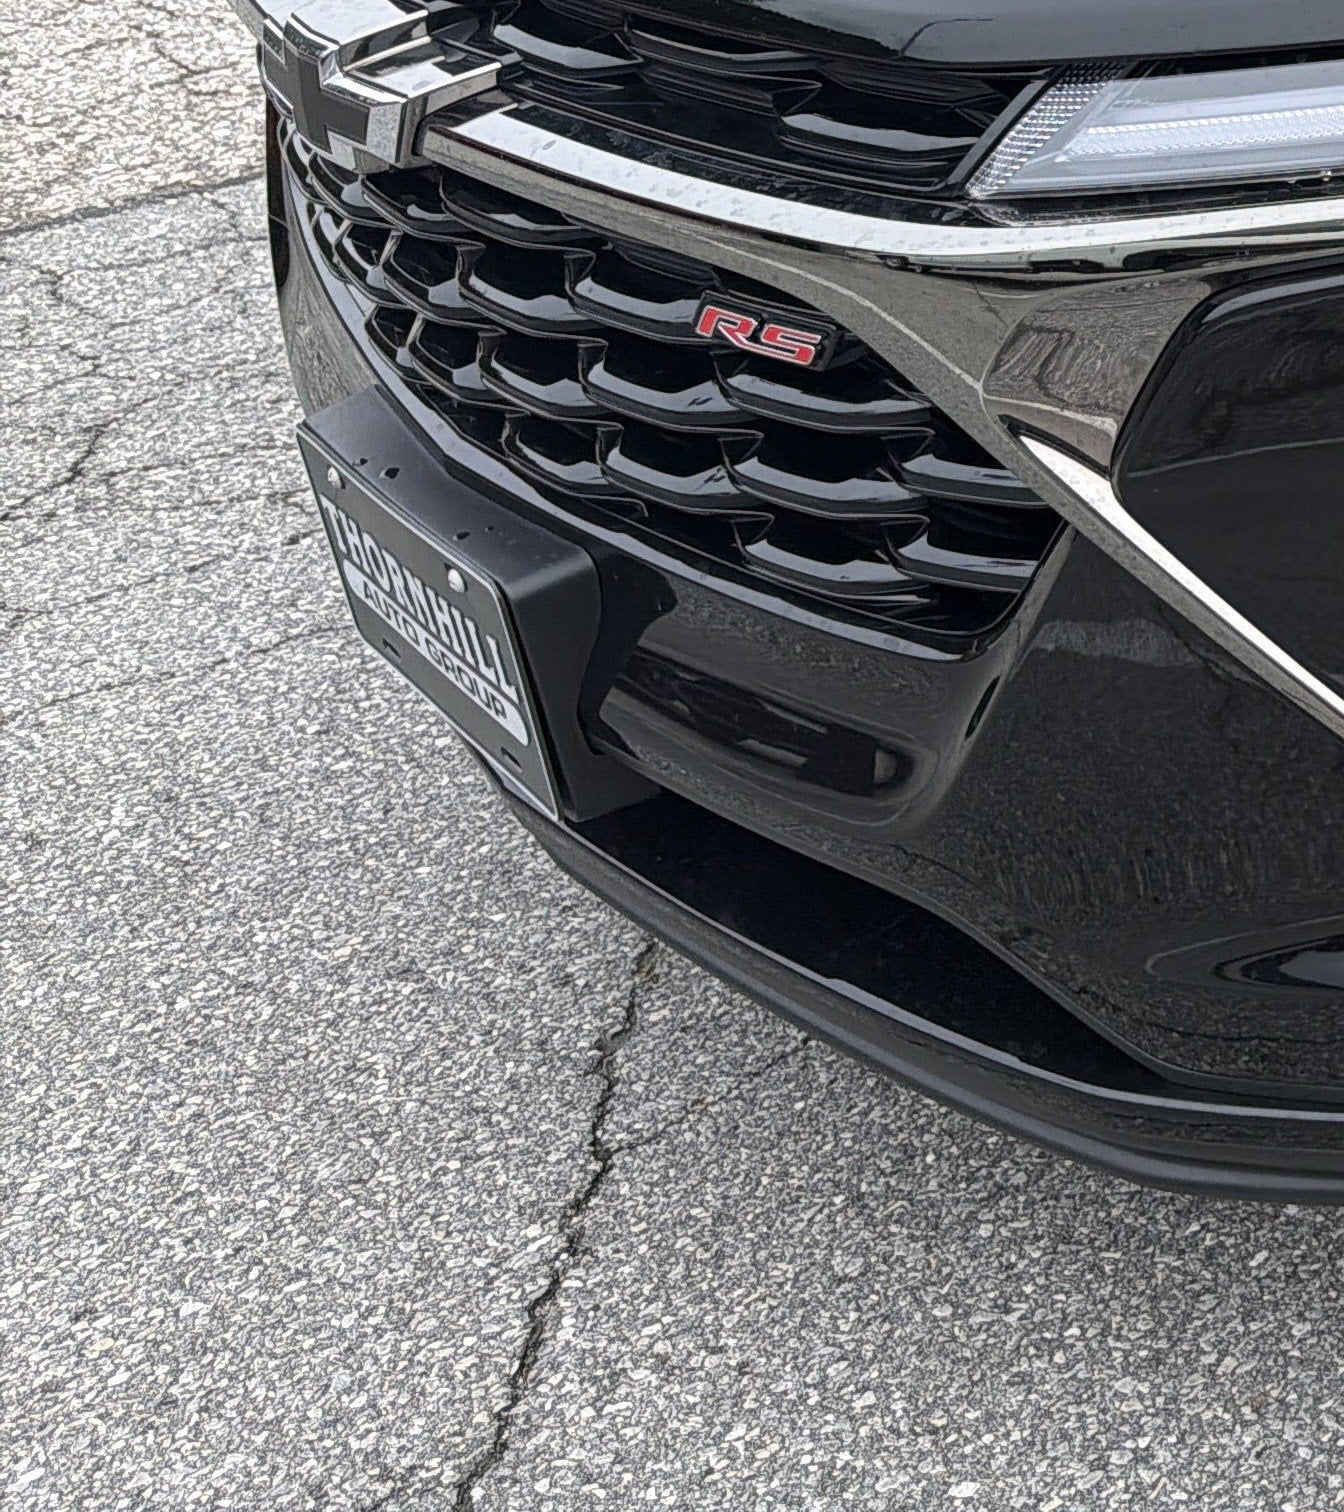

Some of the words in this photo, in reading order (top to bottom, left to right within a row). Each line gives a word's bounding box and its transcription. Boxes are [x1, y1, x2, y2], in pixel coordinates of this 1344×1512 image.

[695, 304, 822, 366] RS
[319, 493, 522, 706] THORNHILL
[363, 580, 422, 641] AUTO
[425, 640, 508, 719] GROUP
